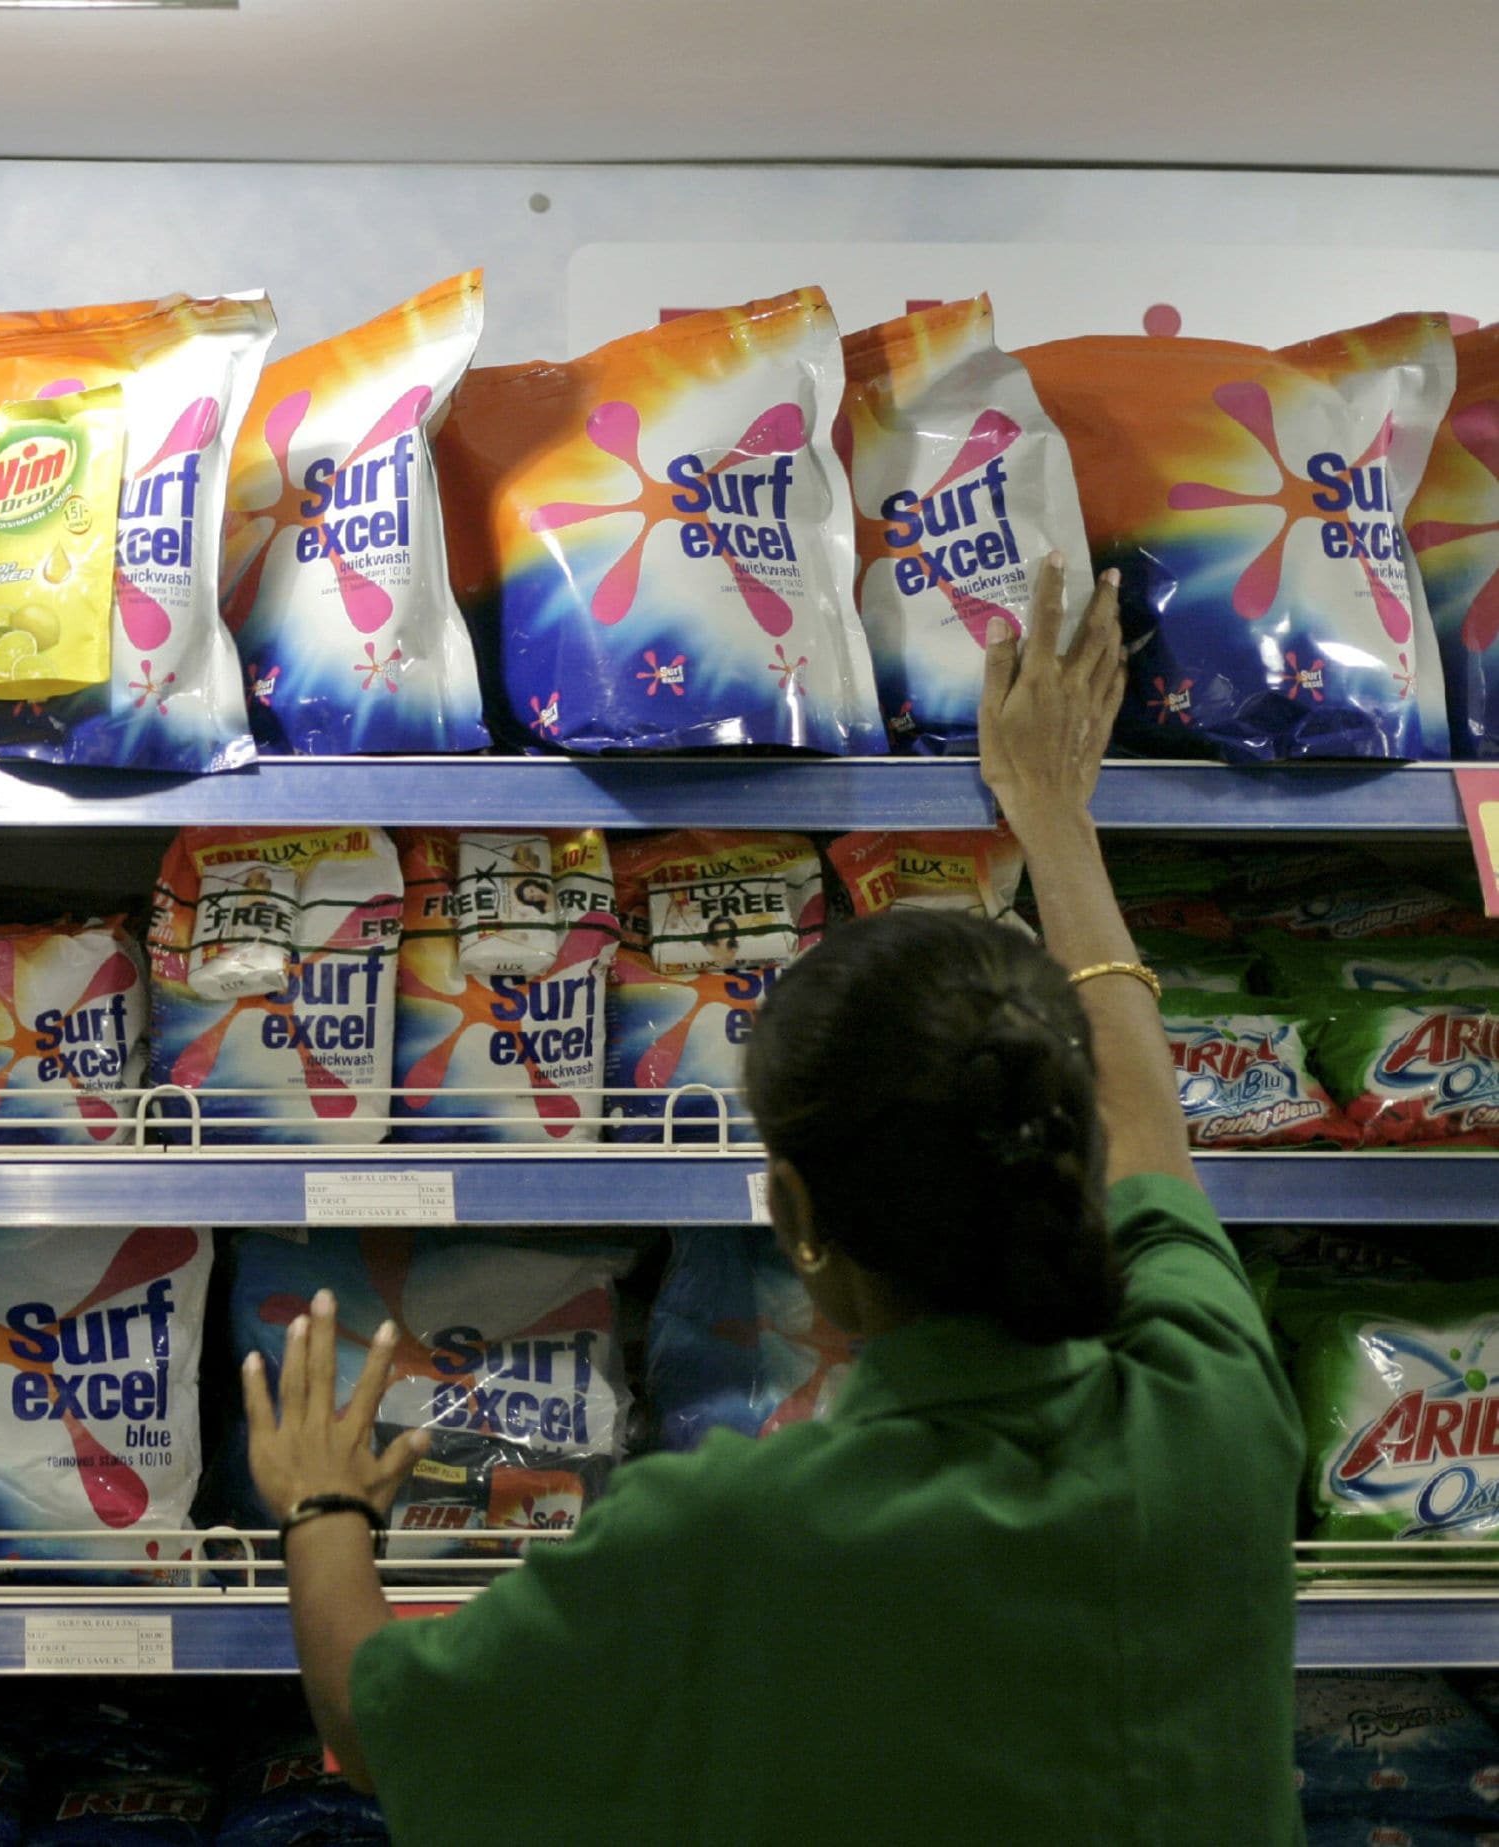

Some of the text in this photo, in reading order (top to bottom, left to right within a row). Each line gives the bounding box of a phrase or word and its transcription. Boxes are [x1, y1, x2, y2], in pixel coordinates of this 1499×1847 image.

[117, 453, 200, 520] urf
[301, 434, 414, 518] Surf
[667, 453, 793, 520] Surf
[1307, 452, 1392, 512] Su
[1, 487, 53, 513] Drop
[881, 455, 1007, 548] Surf
[296, 500, 409, 563] excel
[680, 521, 797, 562] excel
[340, 550, 410, 575] quickwash
[735, 561, 800, 577] quickwash
[895, 519, 1021, 596] excel
[952, 568, 1025, 599] quickwash
[660, 666, 683, 677] Surf
[1301, 670, 1322, 682] Surf
[262, 839, 308, 863] LUX
[701, 857, 740, 879] LUX
[901, 858, 947, 877] LUX
[689, 883, 747, 901] LUX
[701, 894, 784, 919] FREE
[213, 905, 292, 932] FREE
[684, 961, 719, 970] LUX
[490, 959, 598, 1021] Surf
[35, 993, 127, 1050] Surf
[262, 1007, 376, 1049] excel
[490, 1018, 593, 1065] excel
[1384, 1013, 1499, 1073] ARI
[38, 1042, 127, 1082] excel
[307, 1053, 373, 1066] quickwash
[535, 1061, 593, 1079] quickwash
[1204, 1101, 1320, 1138] Spring Clean
[6, 1278, 174, 1365] Surf
[432, 1326, 597, 1393] Surf
[12, 1359, 168, 1421] excel
[432, 1382, 588, 1444] excel
[126, 1424, 171, 1447] blue
[47, 1452, 171, 1467] removes stains 10/10
[403, 1505, 472, 1528] RIN
[533, 1512, 575, 1530] Surf
